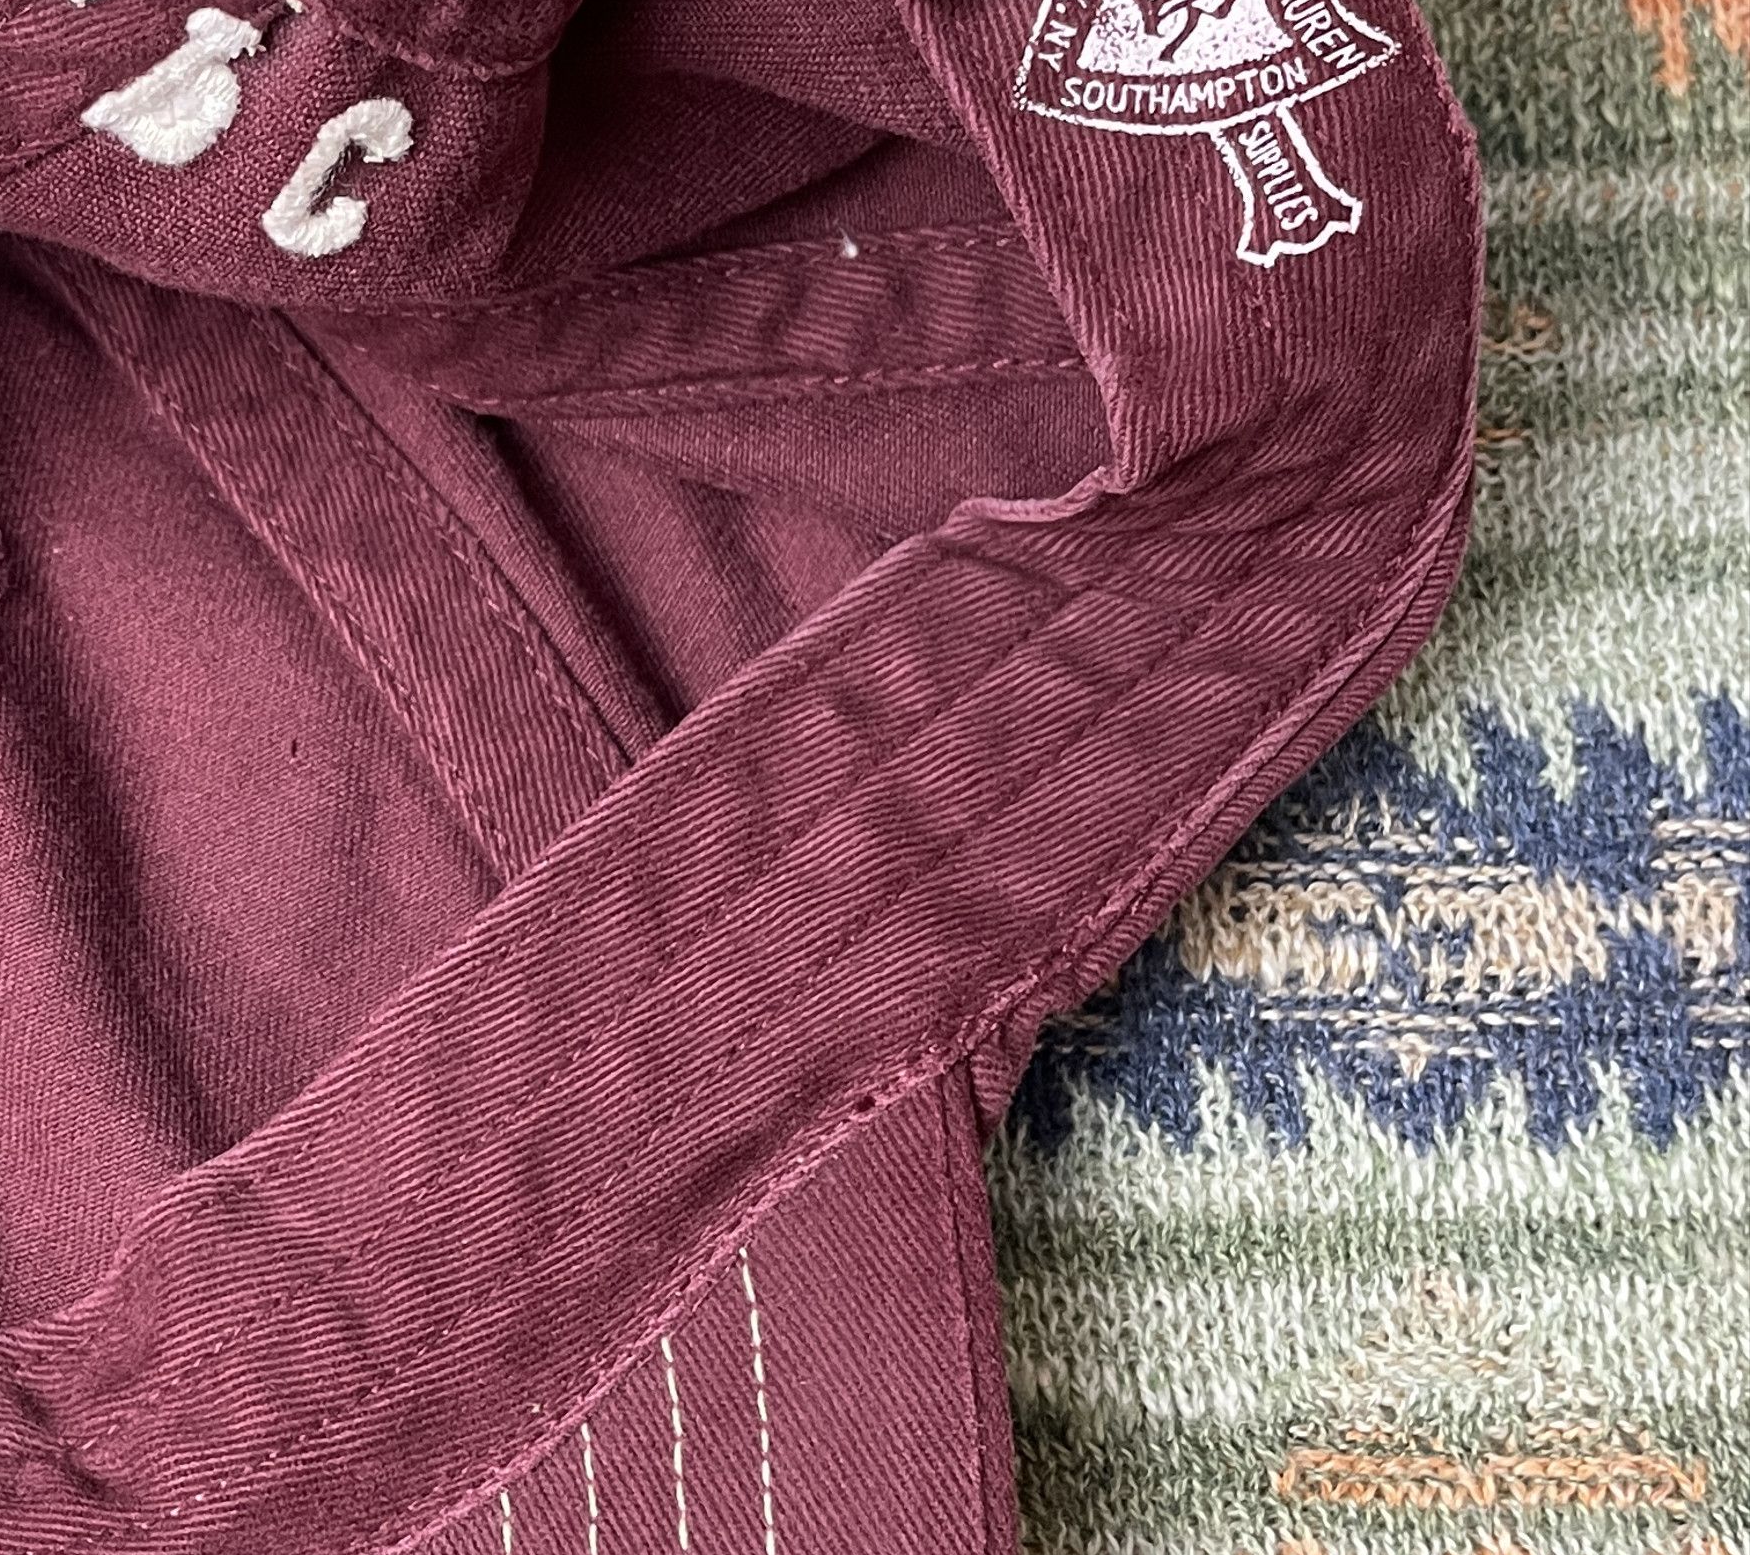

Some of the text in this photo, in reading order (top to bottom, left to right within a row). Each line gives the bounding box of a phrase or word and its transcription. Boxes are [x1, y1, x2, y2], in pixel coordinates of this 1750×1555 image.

[1038, 21, 1077, 72] NY
[1064, 58, 1309, 114] SOUTHAMPTON
[1238, 121, 1319, 230] SUPPLIES
